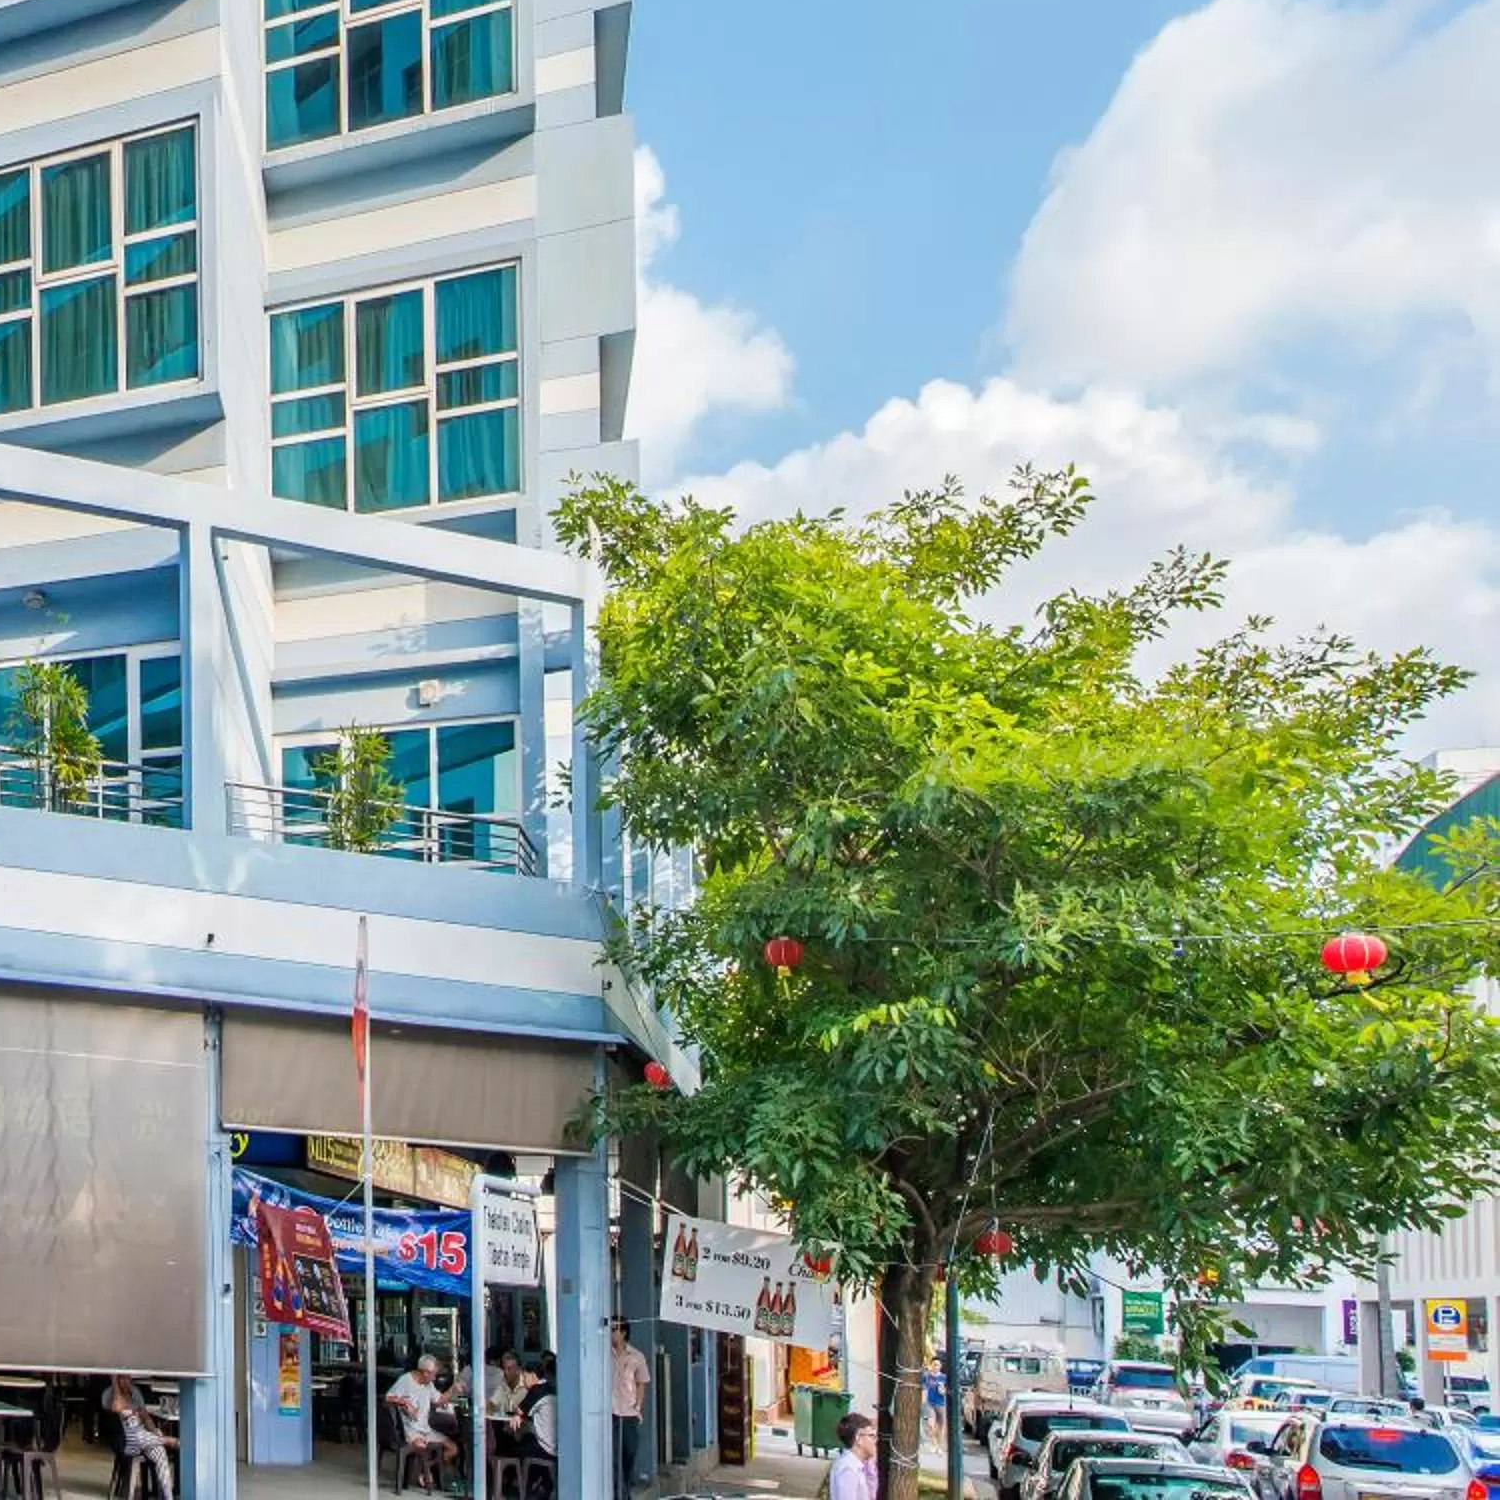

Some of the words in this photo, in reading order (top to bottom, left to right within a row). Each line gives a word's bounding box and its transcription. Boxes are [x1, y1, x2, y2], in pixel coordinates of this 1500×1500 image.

[396, 1231, 467, 1276] $15
[701, 1246, 711, 1260] 2
[732, 1252, 770, 1270] $9.20
[675, 1294, 683, 1307] 3
[705, 1299, 751, 1320] $13.50
